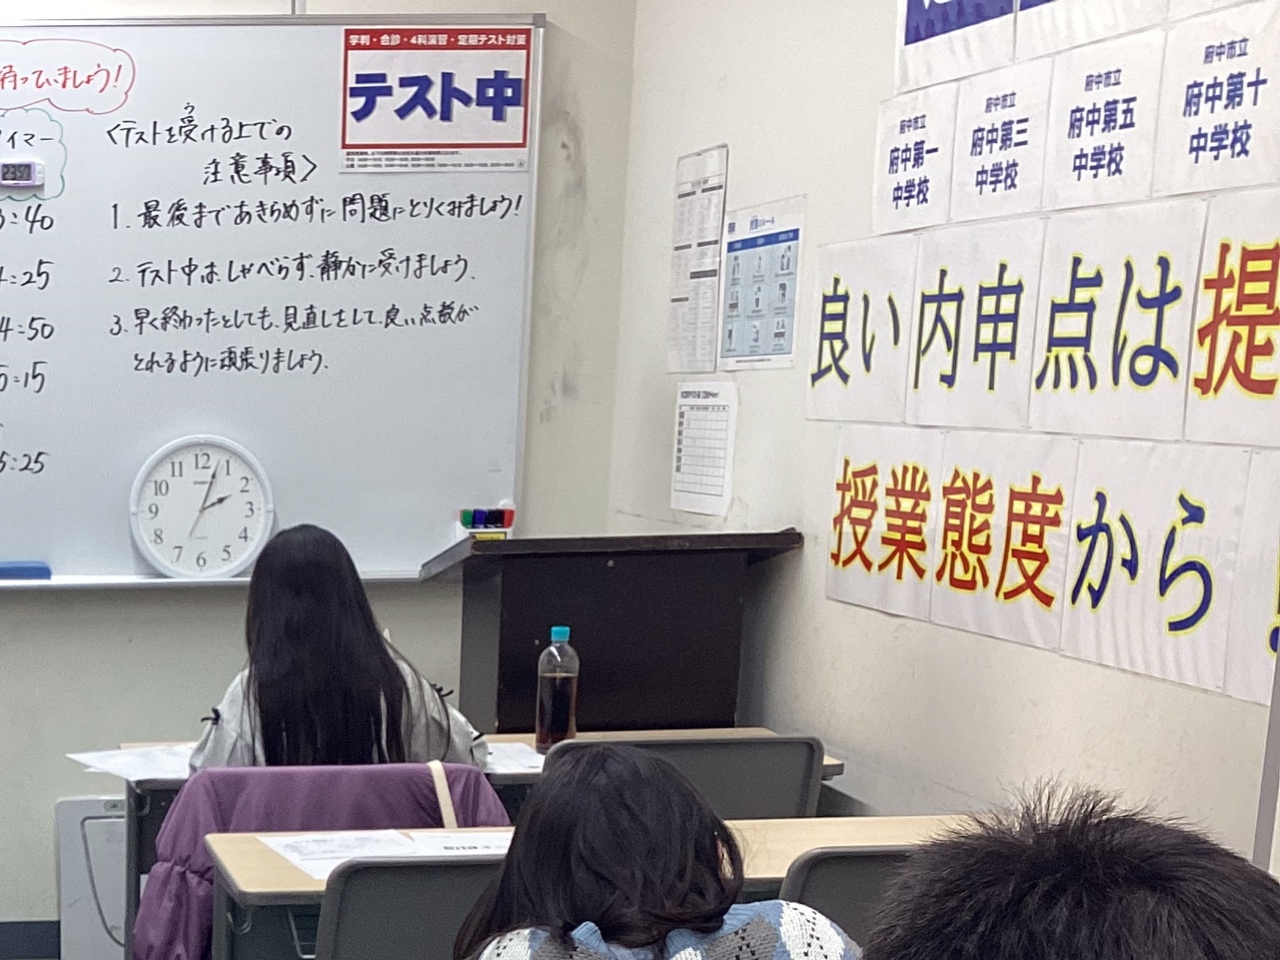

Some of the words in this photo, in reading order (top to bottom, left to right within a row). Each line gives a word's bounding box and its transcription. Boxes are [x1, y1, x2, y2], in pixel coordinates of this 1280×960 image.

[1204, 38, 1249, 64] 府中市立
[1085, 69, 1121, 91] 府中市立
[349, 70, 524, 122] テスト中
[1183, 68, 1267, 117] 府中第十
[985, 93, 1016, 112] 府中市立
[1068, 97, 1137, 138] 府中第五
[971, 117, 1029, 156] 府中第三
[1189, 119, 1252, 164] 中学校
[888, 140, 938, 174] 府中第一
[1072, 143, 1125, 181] 中学校
[975, 159, 1018, 195] 中学校
[892, 177, 930, 209] 中学校
[171, 461, 183, 477] 11
[194, 453, 211, 469] 12
[225, 459, 231, 475] 1
[154, 479, 169, 496] 10
[240, 476, 249, 492] 2
[149, 503, 159, 519] 9
[245, 501, 254, 517] 3
[154, 529, 163, 544] 8
[238, 526, 248, 542] 4
[173, 546, 183, 562] 7
[196, 551, 206, 567] 6
[222, 545, 231, 561] 5
